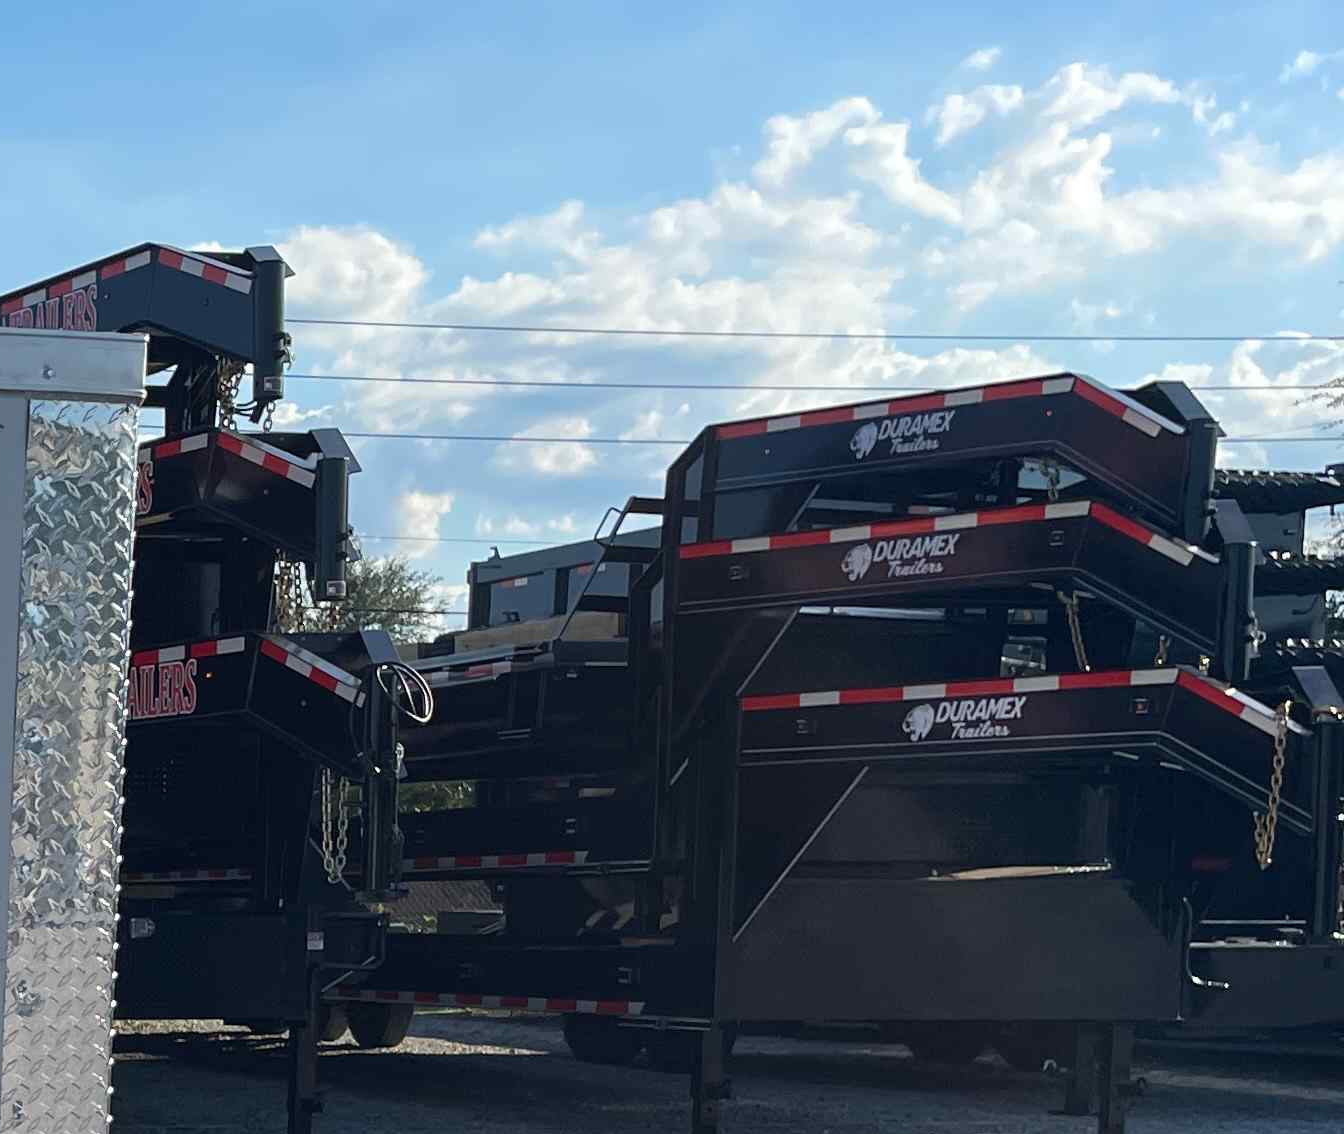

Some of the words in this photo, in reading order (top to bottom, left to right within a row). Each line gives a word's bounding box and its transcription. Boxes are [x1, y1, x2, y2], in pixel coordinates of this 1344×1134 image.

[878, 410, 956, 440] DURAMEX
[890, 435, 940, 455] Trailers
[873, 533, 960, 562] DURAMEX
[887, 558, 944, 578] Trailers
[936, 696, 1027, 723] DURAMEX
[951, 720, 1010, 739] Trailers
